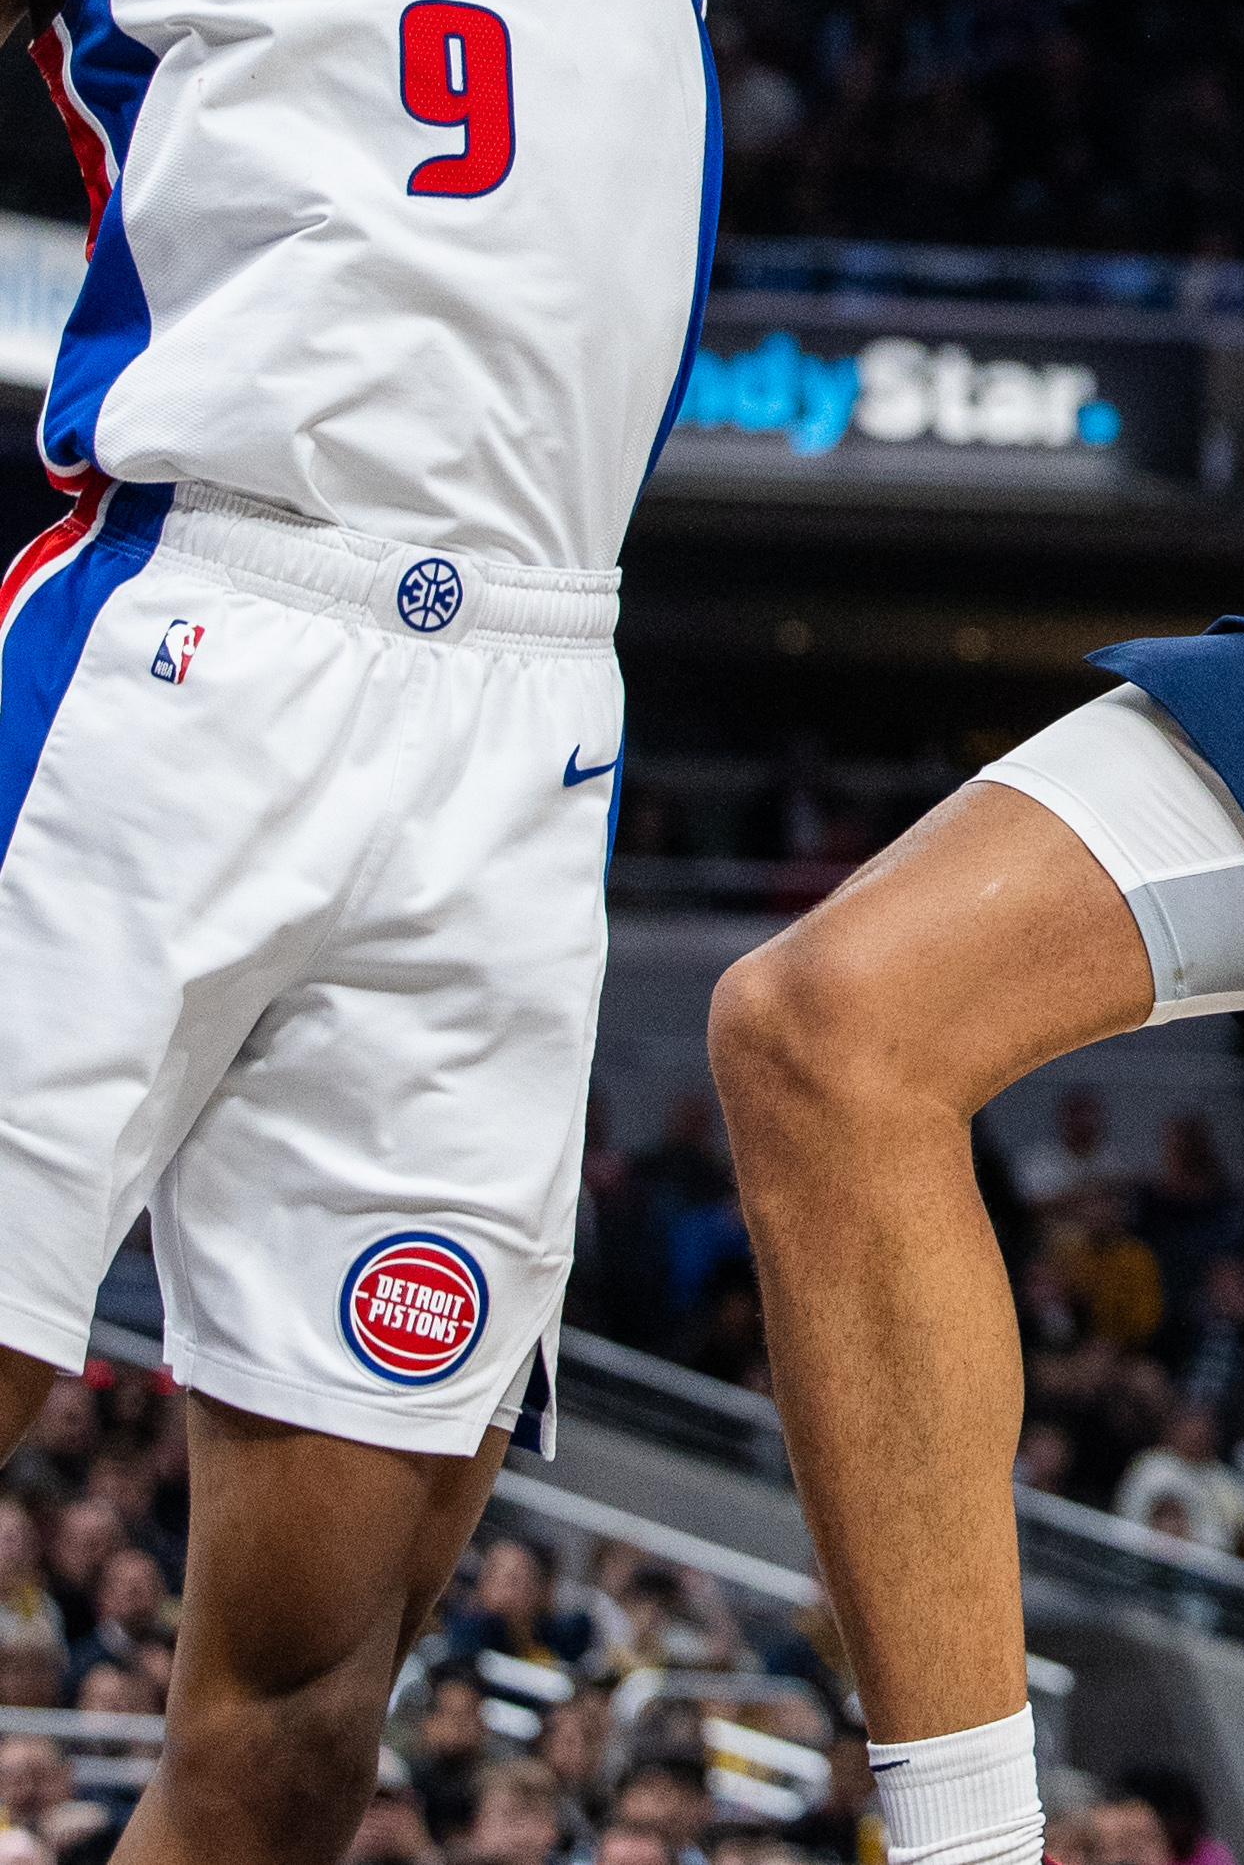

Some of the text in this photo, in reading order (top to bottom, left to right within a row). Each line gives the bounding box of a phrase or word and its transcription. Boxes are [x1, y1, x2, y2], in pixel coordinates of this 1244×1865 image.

[400, 0, 516, 199] 9
[153, 659, 174, 680] NBA
[375, 1273, 466, 1320] DETROIT
[367, 1297, 459, 1345] PISTONS
